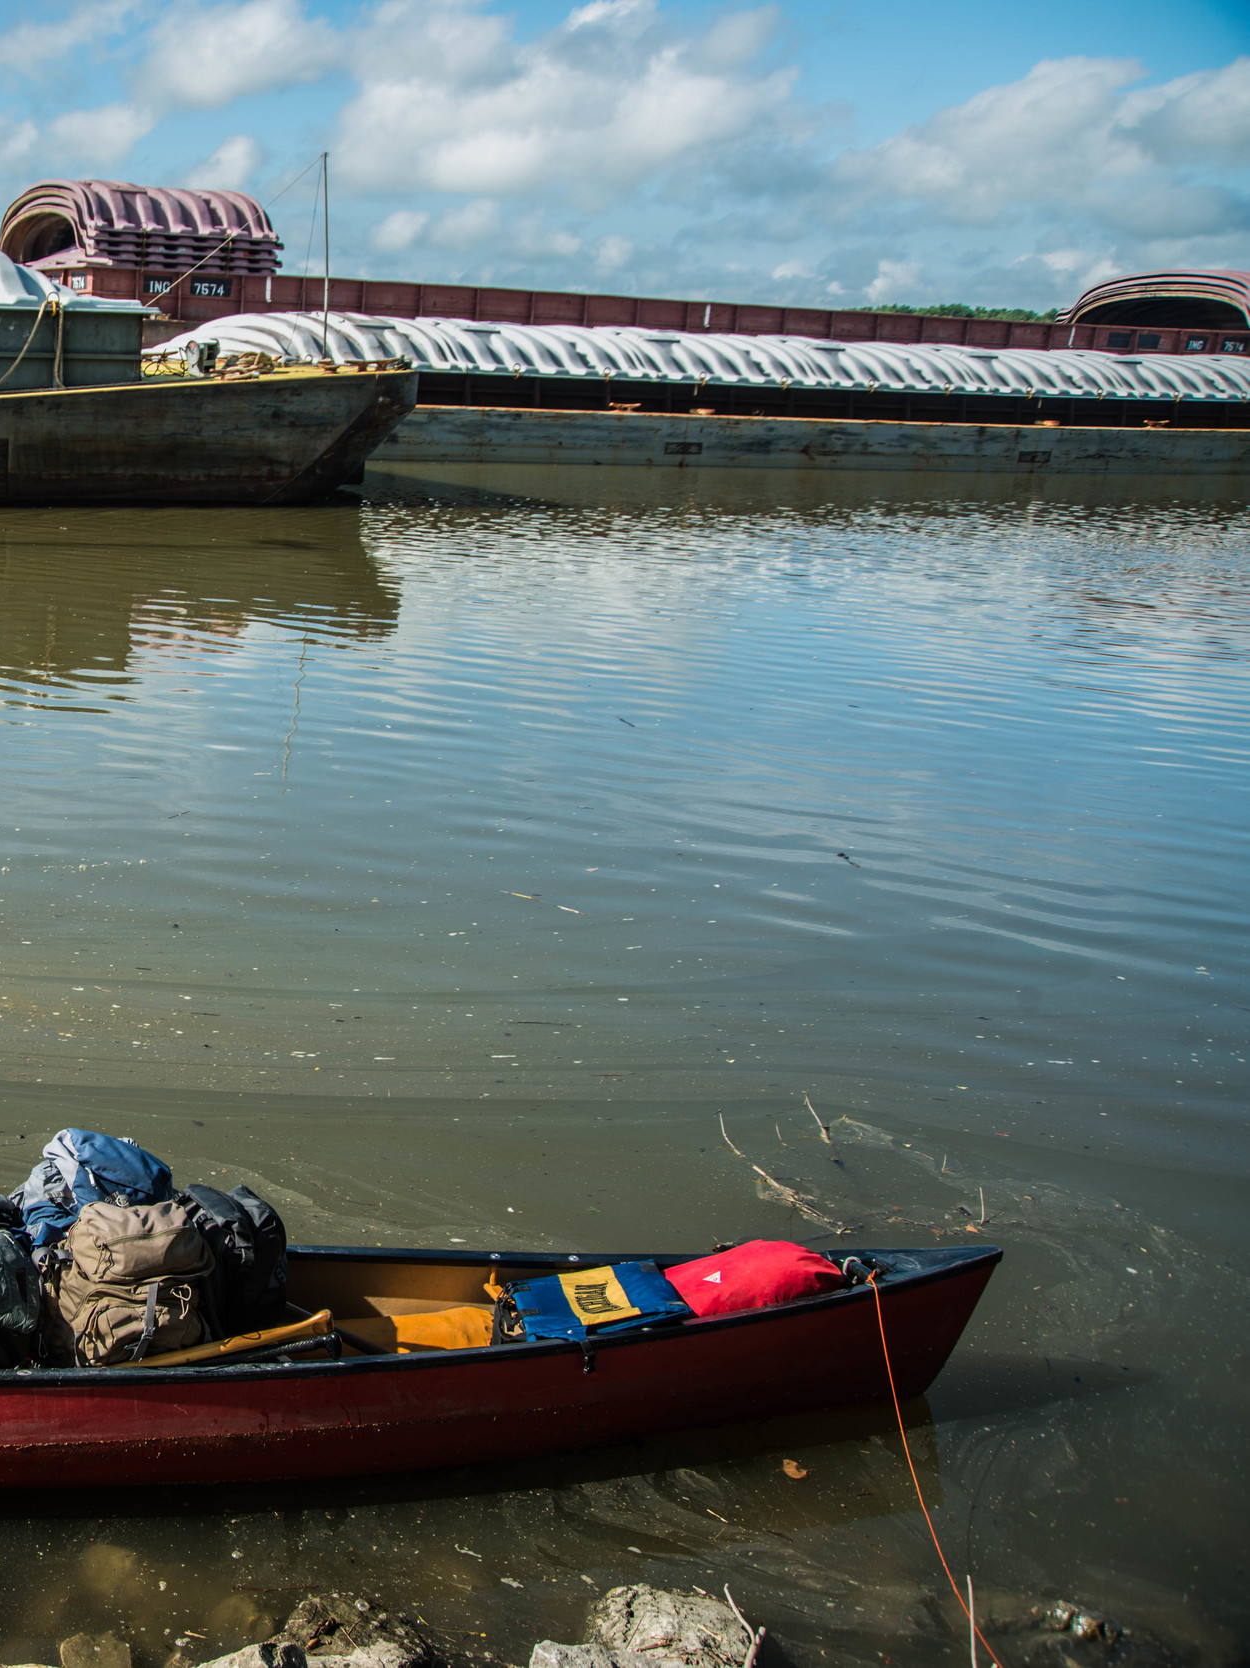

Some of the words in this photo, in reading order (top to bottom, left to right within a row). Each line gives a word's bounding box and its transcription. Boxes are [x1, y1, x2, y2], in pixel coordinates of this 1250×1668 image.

[149, 280, 172, 294] ING
[193, 282, 225, 297] 7574
[1187, 340, 1203, 350] ING
